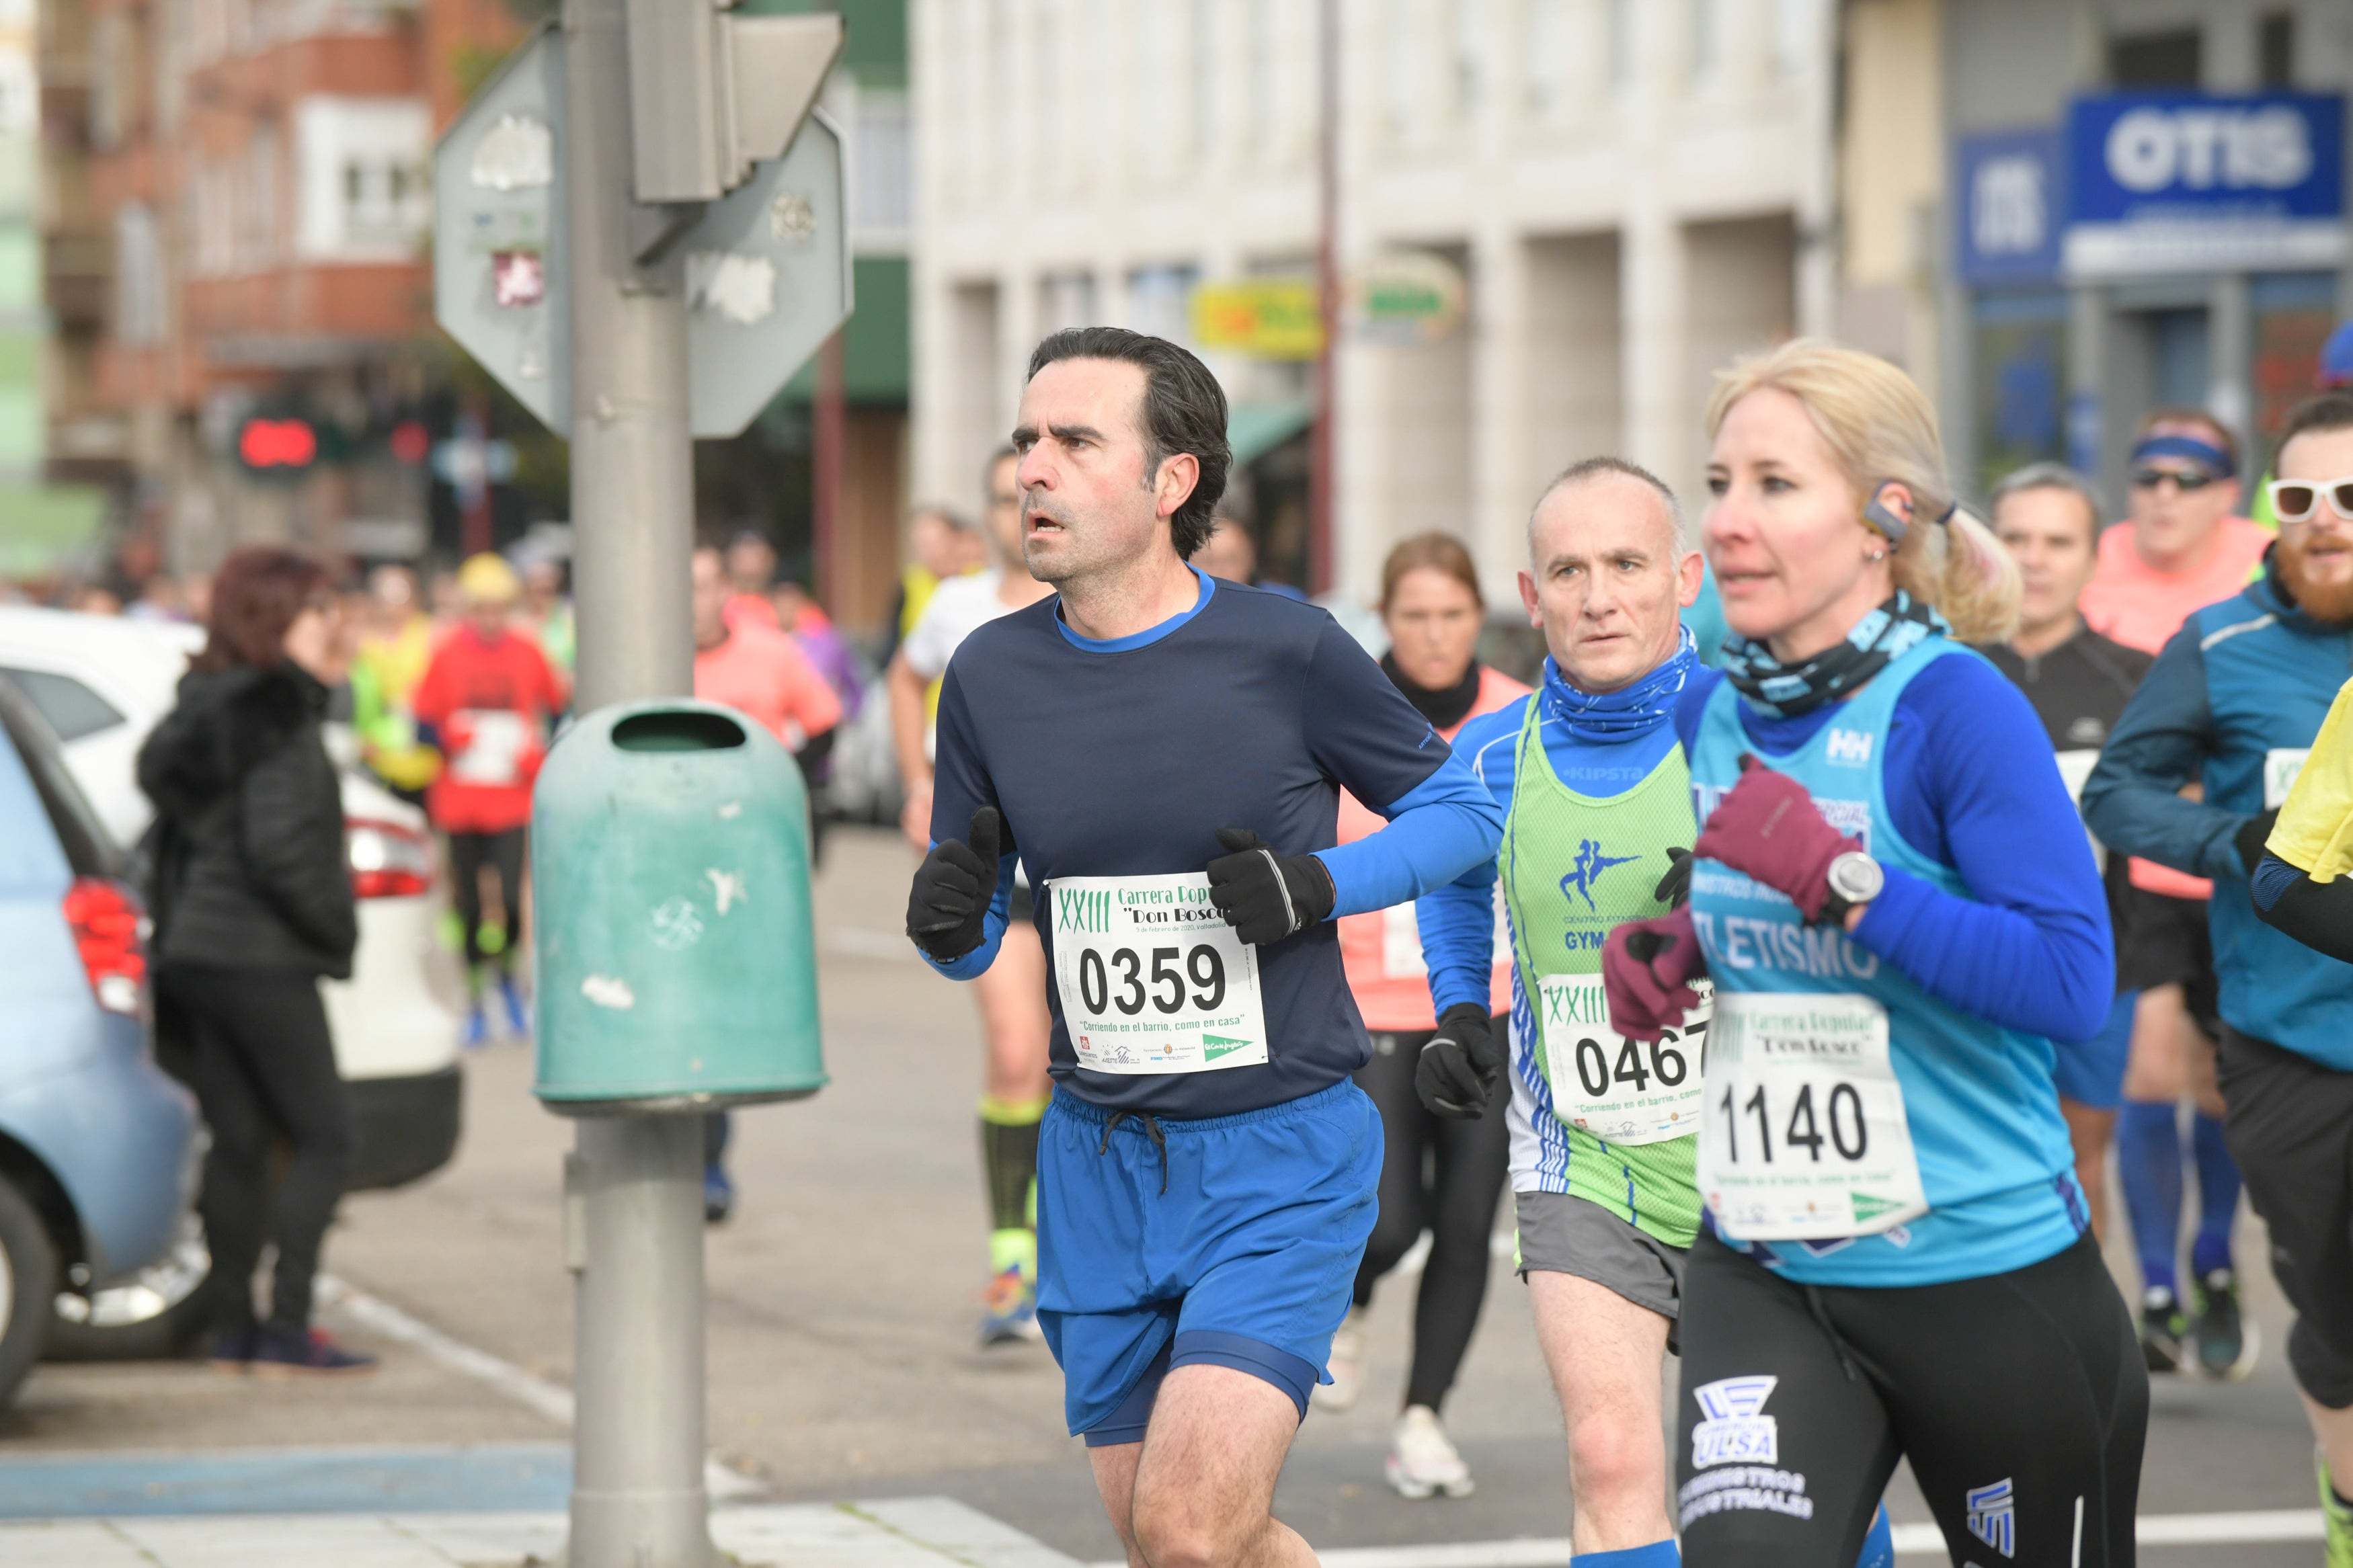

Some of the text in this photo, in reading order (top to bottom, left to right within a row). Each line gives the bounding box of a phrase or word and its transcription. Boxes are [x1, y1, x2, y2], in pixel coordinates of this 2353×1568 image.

[2105, 106, 2314, 192] OTIS
[1826, 727, 1873, 761] HH
[1570, 766, 1644, 781] KIPSTA
[1058, 887, 1110, 934] XXIII
[1117, 887, 1173, 905] Carrera
[1197, 921, 1226, 930] Valladolid
[1565, 931, 1604, 950] GYM
[1691, 909, 1879, 980] TLETISMO
[1080, 944, 1226, 1016] 0359
[1548, 985, 1606, 1027] XXIII
[1120, 1024, 1129, 1032] en
[1132, 1022, 1141, 1032] el
[1143, 1021, 1172, 1032] barrio,
[1174, 1020, 1200, 1031] como
[1203, 1020, 1215, 1028] en
[1576, 1020, 1708, 1097] 0467
[1624, 1101, 1634, 1109] en
[1638, 1098, 1646, 1107] el
[1648, 1095, 1677, 1106] barrio,
[1680, 1087, 1702, 1100] como
[1720, 1083, 1867, 1163] 1140
[1698, 1434, 1771, 1462] ULSA
